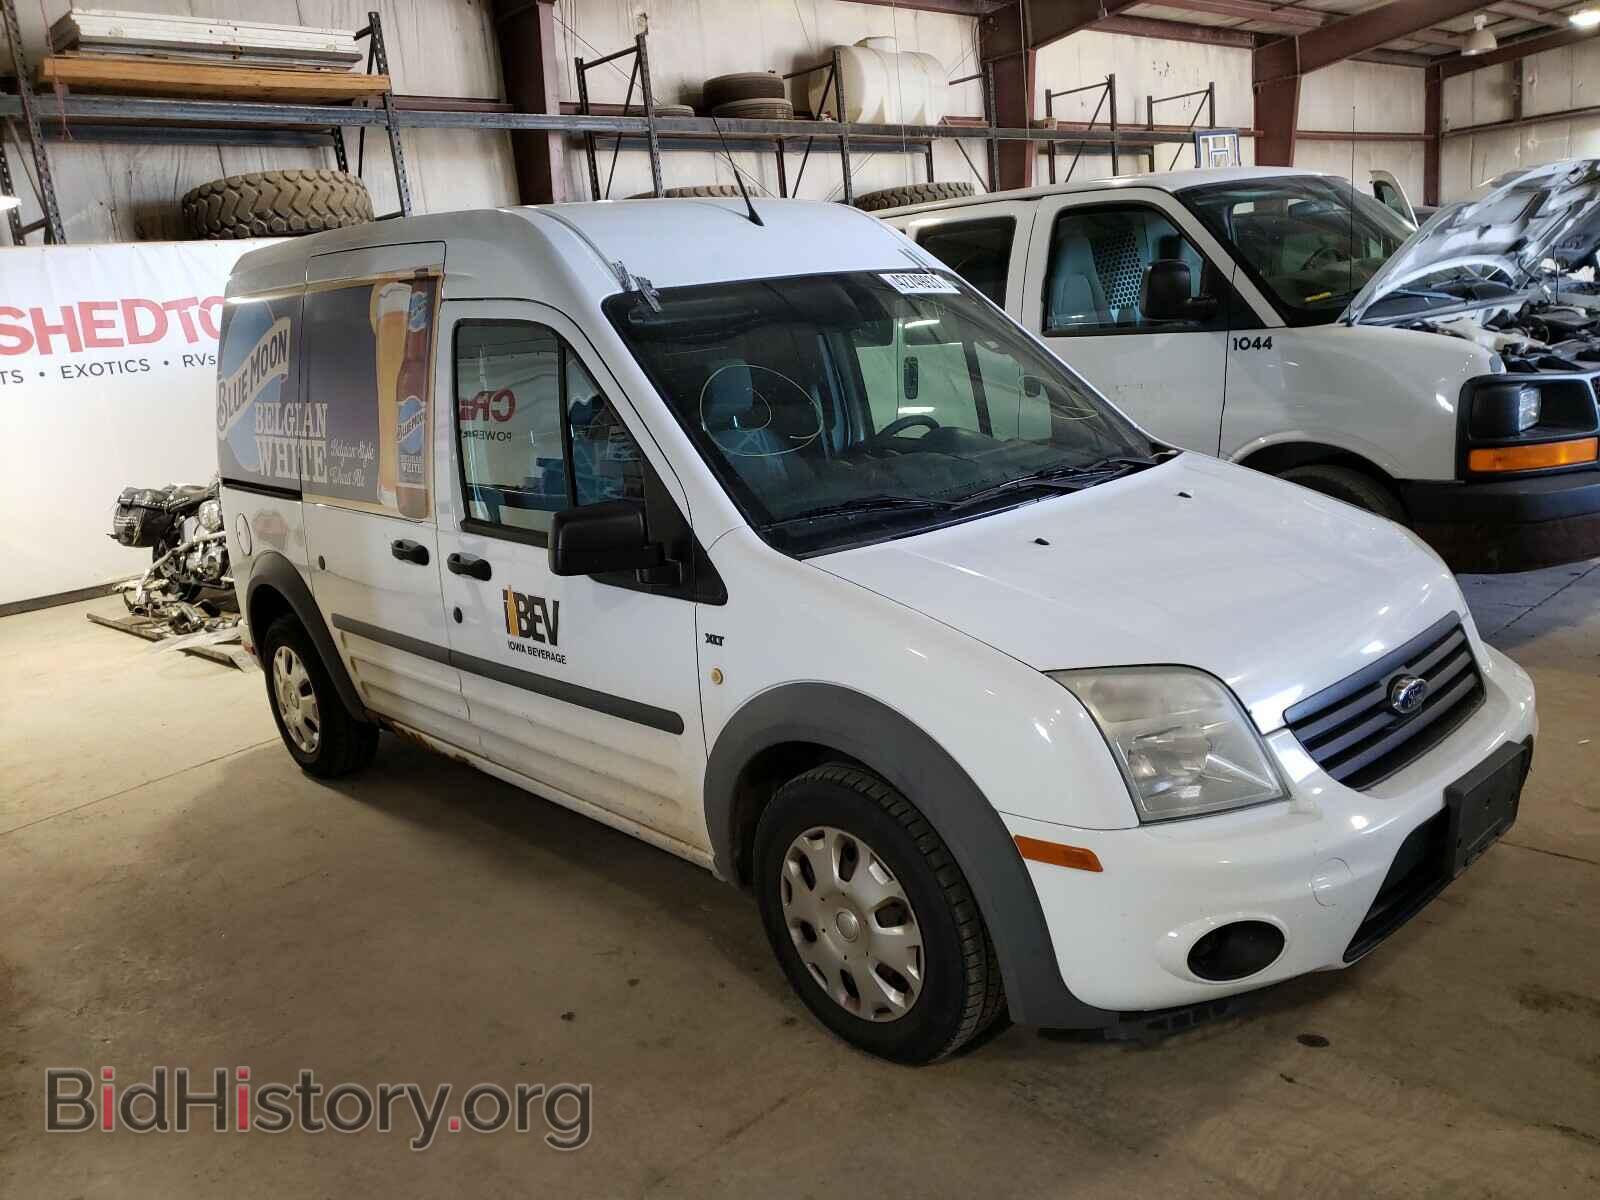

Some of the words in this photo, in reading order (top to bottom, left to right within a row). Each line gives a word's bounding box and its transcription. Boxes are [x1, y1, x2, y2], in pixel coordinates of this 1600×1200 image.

[1233, 337, 1272, 351] 1044
[61, 358, 151, 379] EXOTICS
[183, 352, 217, 368] RVs
[217, 368, 248, 432] BLUE
[249, 329, 289, 392] MOON
[255, 402, 328, 438] BELGIAN
[257, 436, 328, 484] WHITE
[507, 640, 526, 655] IOWA
[527, 646, 567, 665] BEVERAGE
[705, 632, 725, 646] XLT
